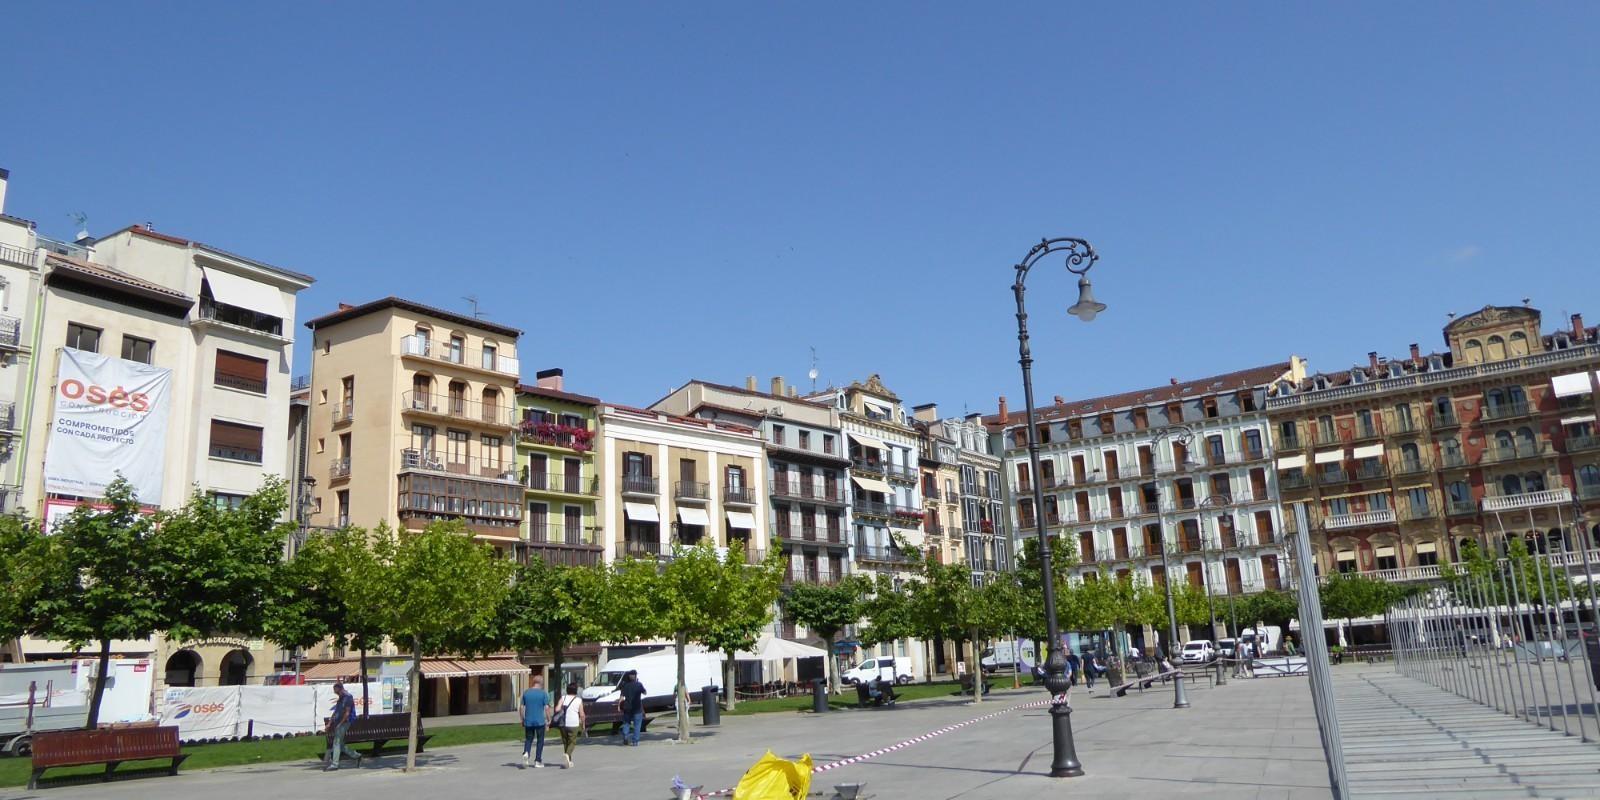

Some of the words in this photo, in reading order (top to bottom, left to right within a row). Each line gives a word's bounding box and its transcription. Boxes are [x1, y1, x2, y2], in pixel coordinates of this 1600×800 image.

[56, 427, 74, 436] CON
[74, 430, 96, 440] CADA
[58, 418, 134, 437] COMPROMETIDOS
